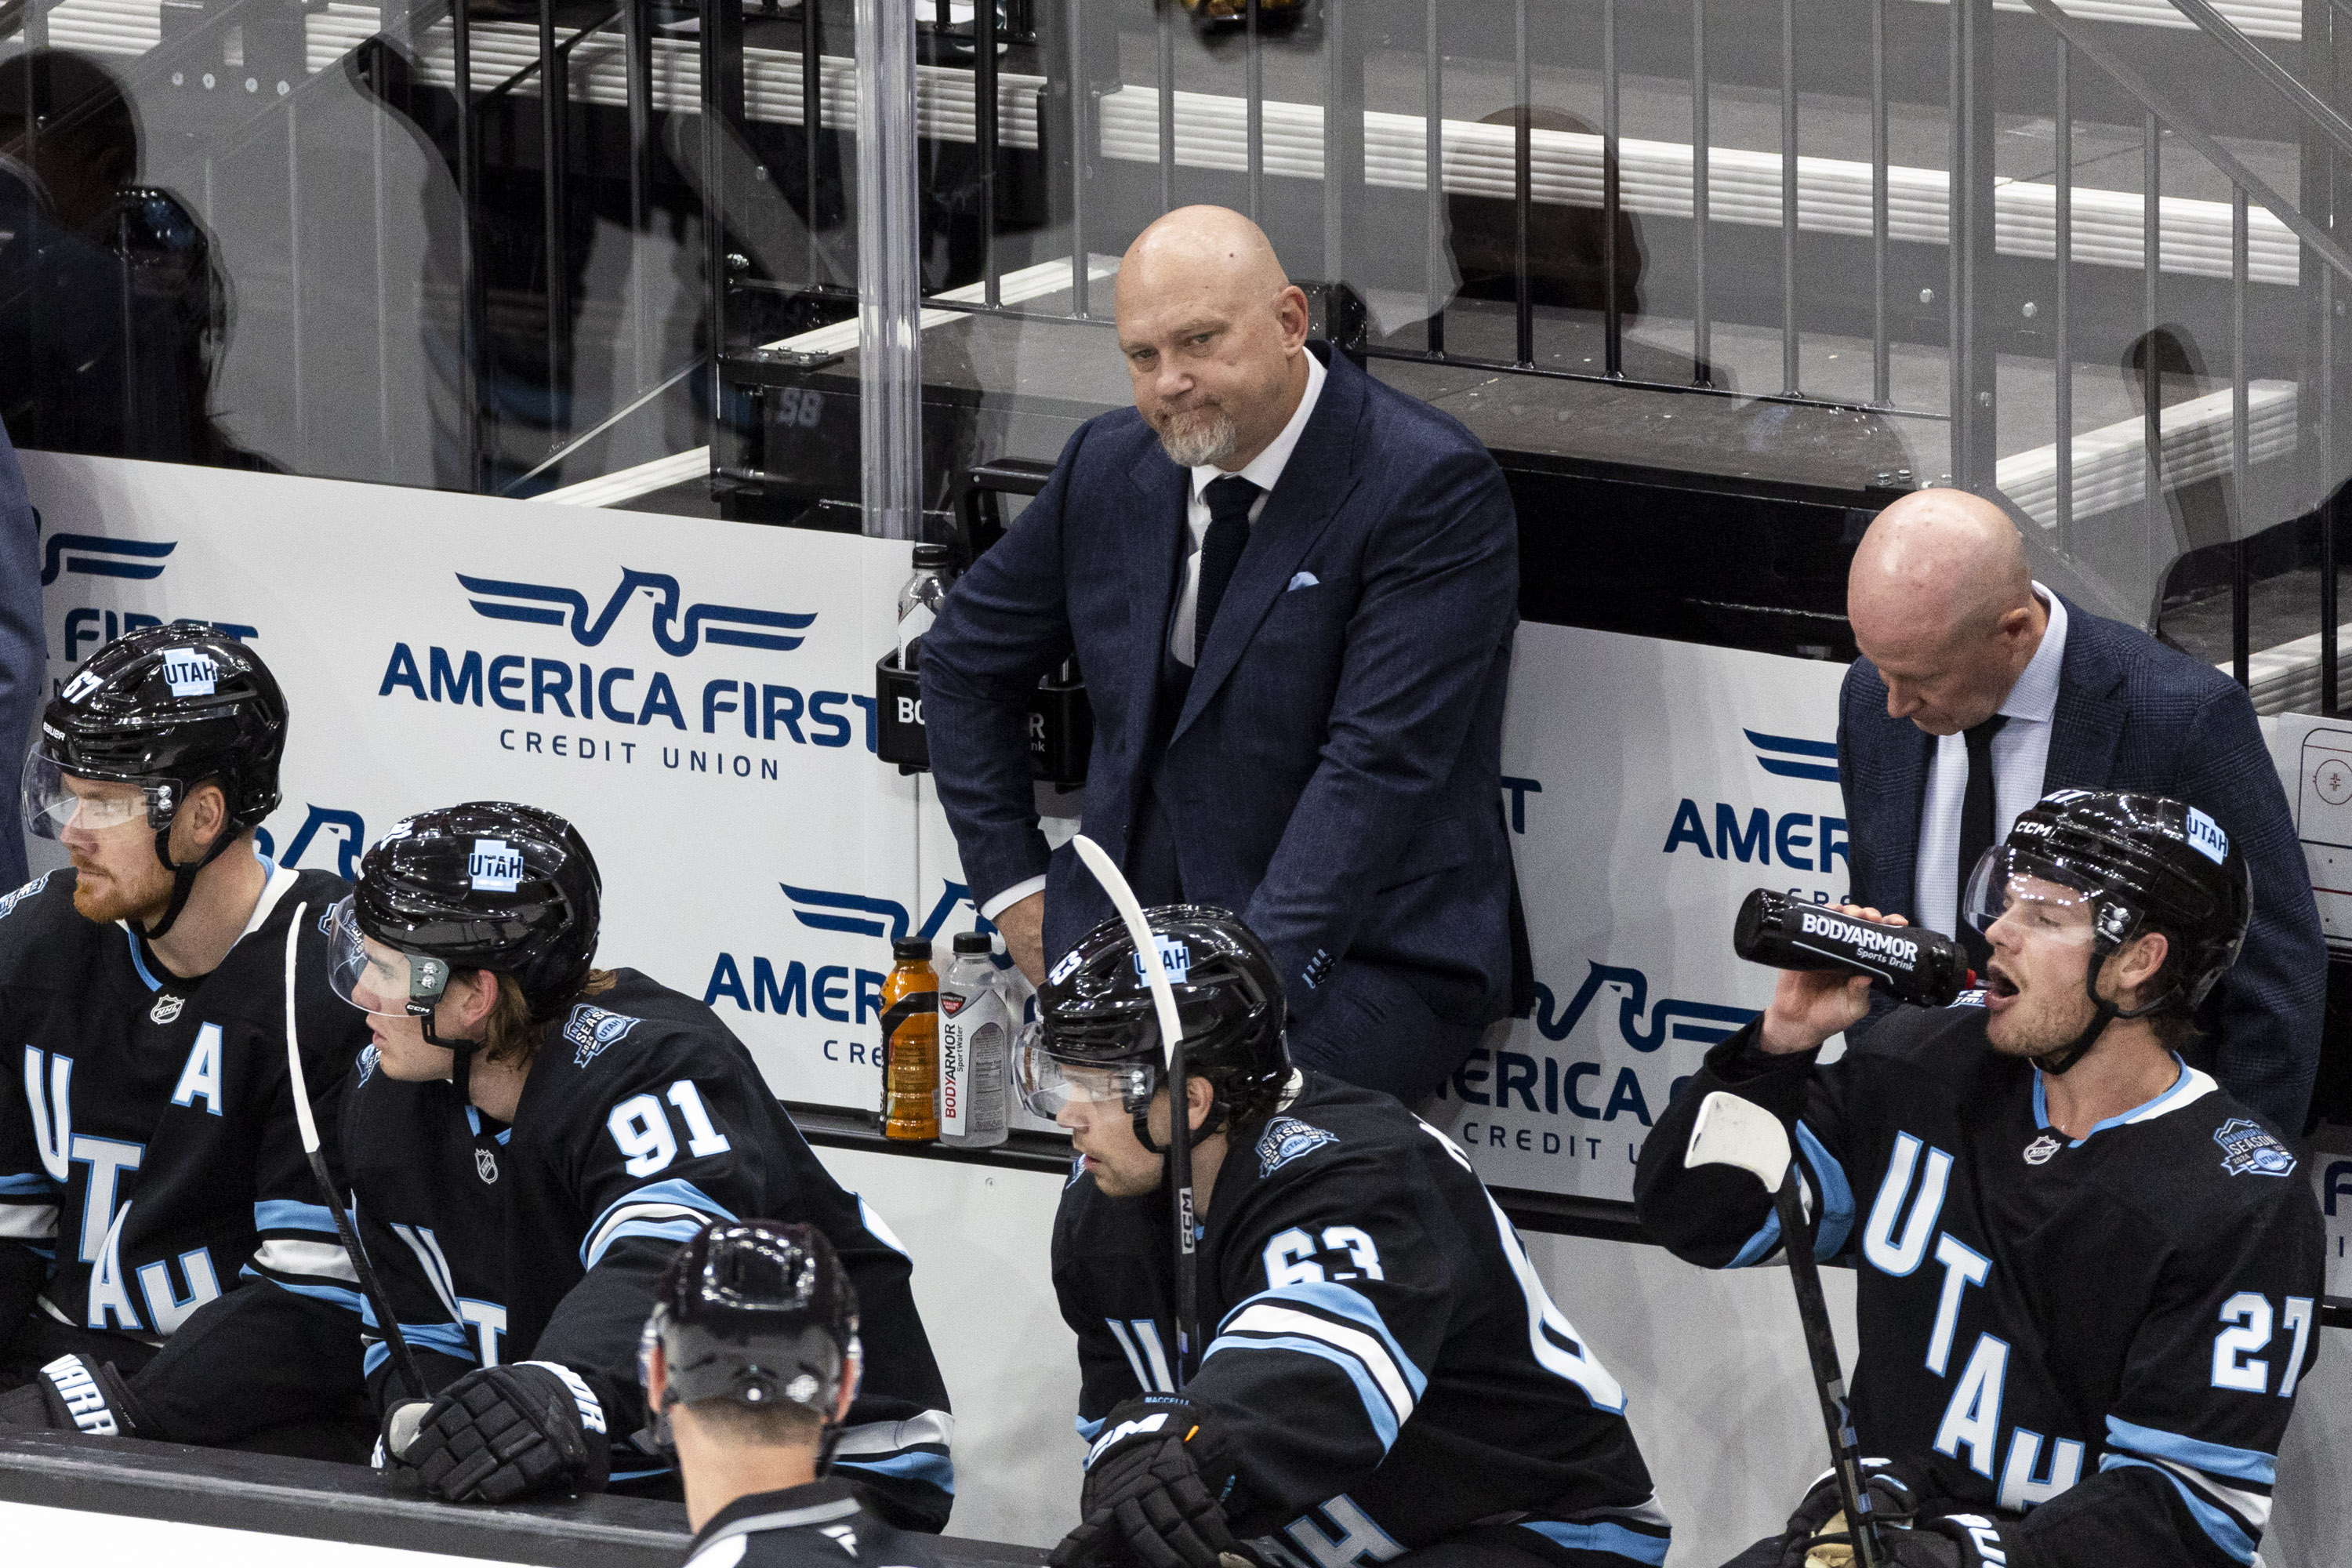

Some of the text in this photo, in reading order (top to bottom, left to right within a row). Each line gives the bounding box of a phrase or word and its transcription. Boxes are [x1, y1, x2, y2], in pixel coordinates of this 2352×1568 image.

[62, 671, 103, 704] 67
[163, 661, 217, 685] UTAH
[379, 642, 687, 731] AMERICA
[500, 729, 779, 781] CREDIT UNION
[1663, 798, 1849, 874] AMER
[2015, 821, 2053, 837] CCM
[2188, 817, 2228, 855] UTAH
[470, 854, 523, 879] UTAH
[1802, 913, 1918, 962] BODYARMOR
[1137, 946, 1189, 974] UAH
[1857, 947, 1915, 972] Sports Drink
[704, 952, 887, 1025] AMER
[406, 1004, 430, 1013] CCM
[581, 1036, 594, 1055] 2024
[598, 1019, 621, 1038] UTAH
[172, 1022, 223, 1116] A
[945, 1023, 956, 1119] BODYARMOR
[1437, 1048, 1653, 1127] ERICA
[607, 1079, 731, 1180] 91
[1263, 1124, 1312, 1157] SEASON
[1283, 1138, 1307, 1154] UTAH
[1463, 1122, 1602, 1160] CREDIT
[2228, 1134, 2278, 1156] SEASON
[2258, 1153, 2283, 1166] UTAH
[1182, 1192, 1194, 1249] CCM
[1262, 1225, 1385, 1290] 63
[1863, 1129, 2085, 1512] UTAH
[2211, 1290, 2315, 1398] 27
